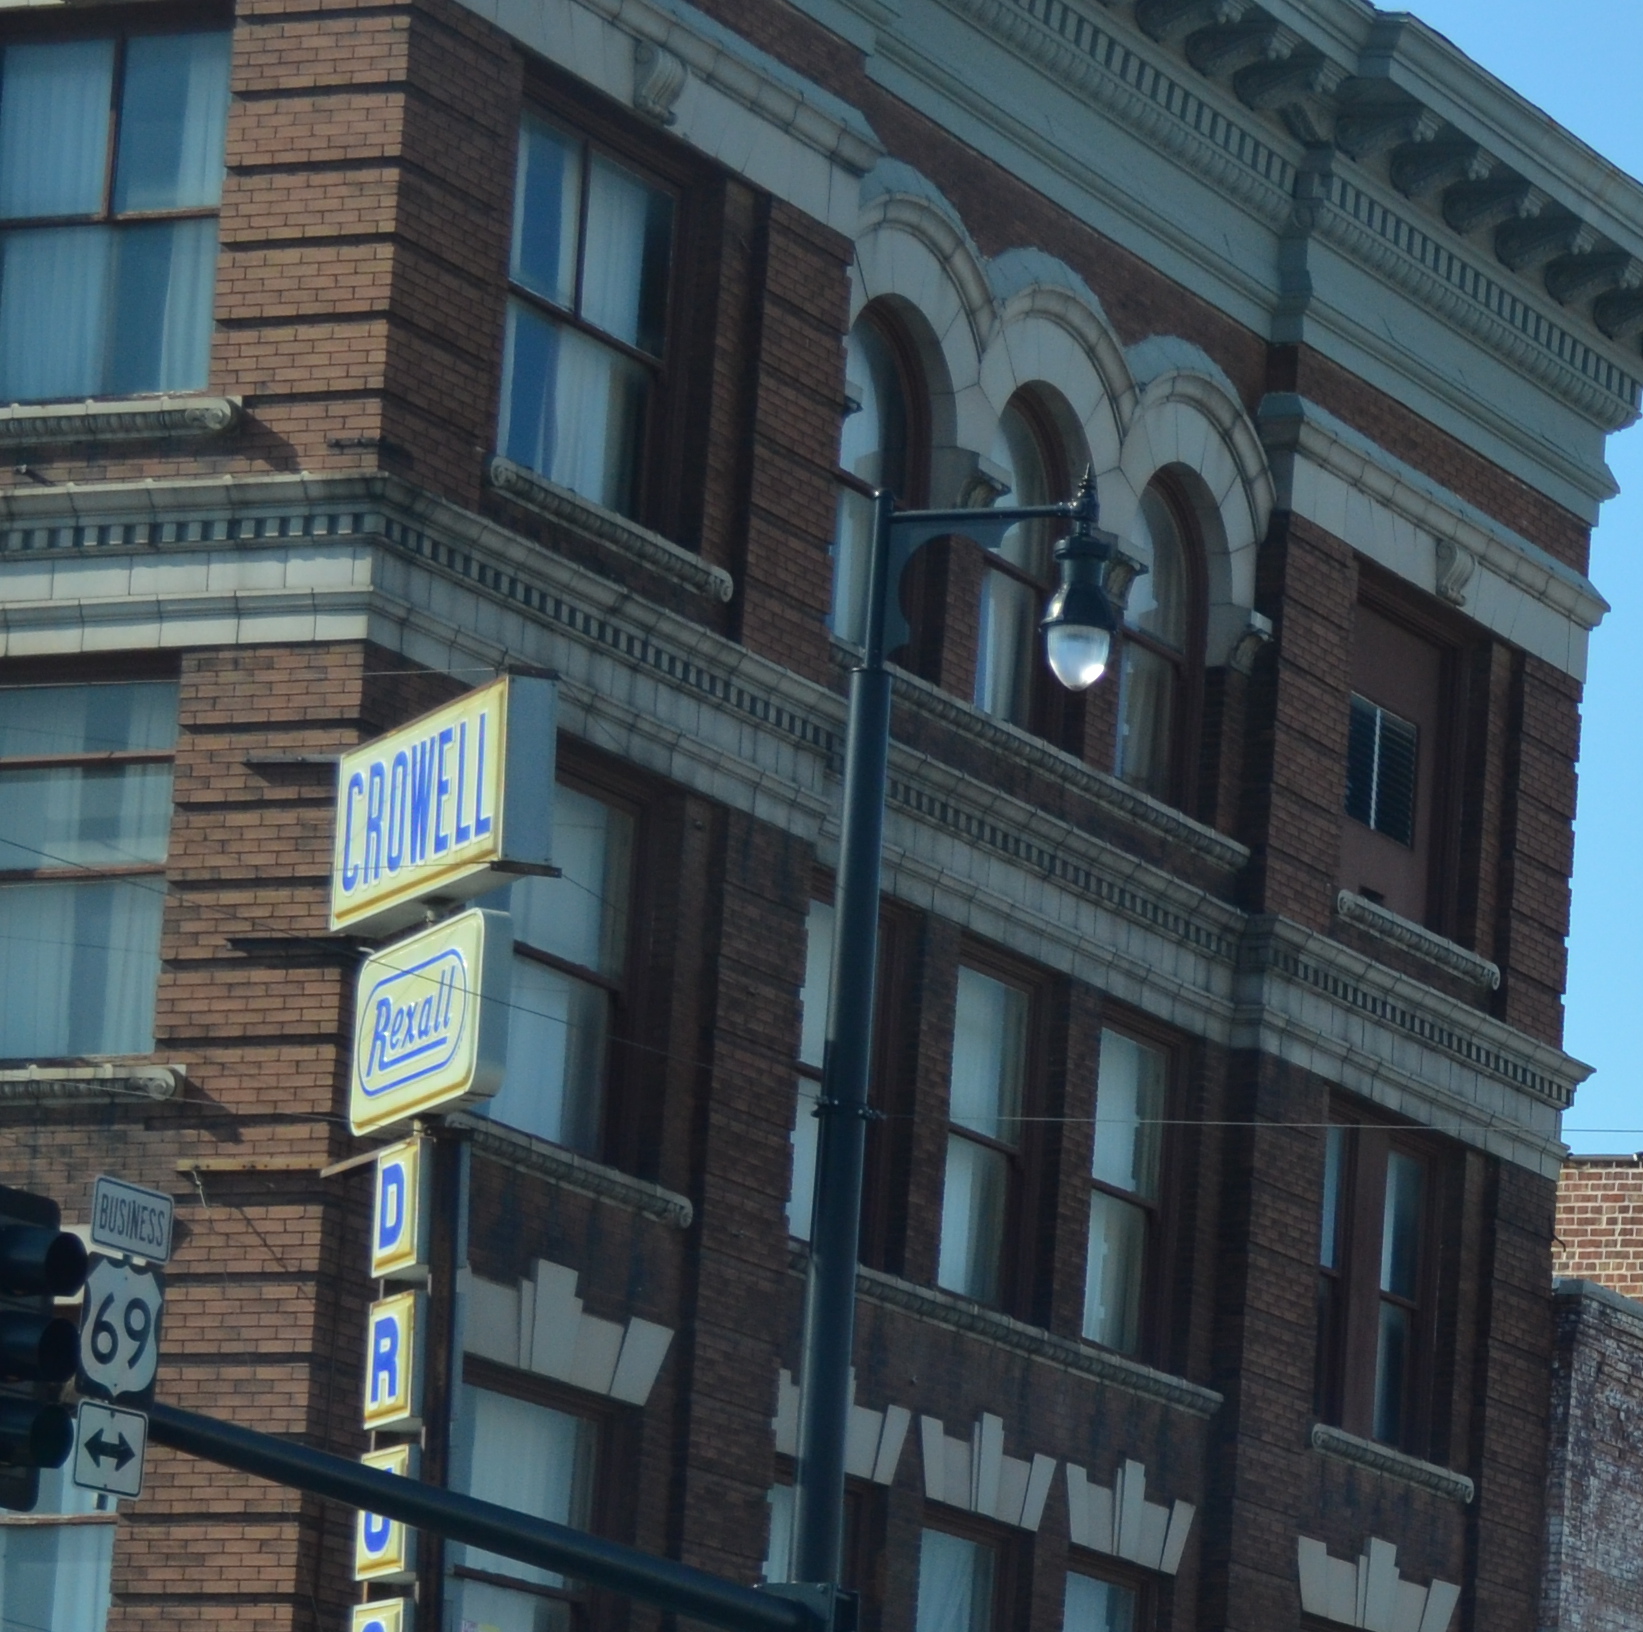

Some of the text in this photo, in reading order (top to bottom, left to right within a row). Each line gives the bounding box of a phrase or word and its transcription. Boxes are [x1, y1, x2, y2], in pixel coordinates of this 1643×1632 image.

[341, 711, 492, 894] CROWELL
[365, 963, 457, 1079] Rexall
[99, 1193, 165, 1247] BUSINESS
[90, 1291, 152, 1370] 69
